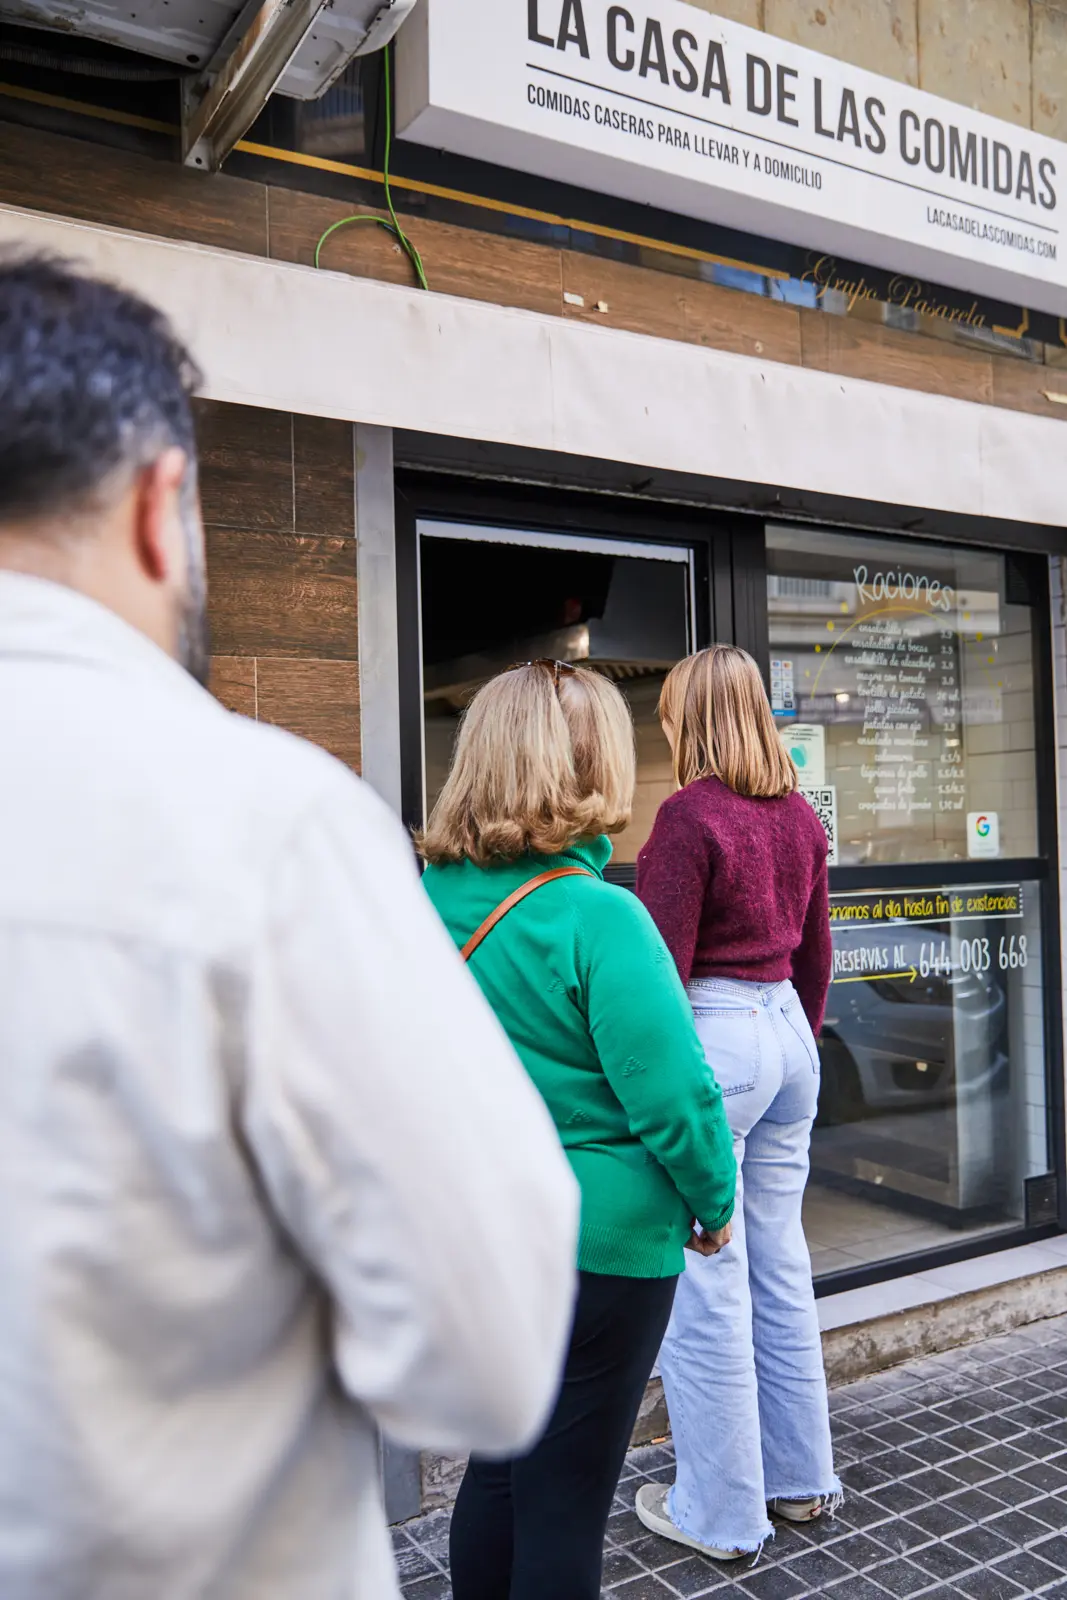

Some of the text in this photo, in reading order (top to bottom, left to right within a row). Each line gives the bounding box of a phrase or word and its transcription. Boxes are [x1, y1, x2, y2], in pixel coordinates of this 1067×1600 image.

[527, 0, 1057, 211] LA CASA DE LAS COMIDAS
[527, 83, 822, 190] COMIDAS CASERAS PARA LLEVAR Y A DOMICILIO
[927, 206, 1057, 260] LACASADELASCOMIDAS.COM
[801, 252, 986, 328] Grupo Pasarela
[853, 565, 954, 611] Raciones
[828, 905, 869, 921] cinamos
[872, 900, 883, 919] al
[904, 897, 934, 916] hasta
[936, 895, 950, 914] fin
[952, 896, 963, 913] de
[967, 893, 1017, 912] existencias
[834, 935, 1027, 978] RESERVAS AL 644 003 668
